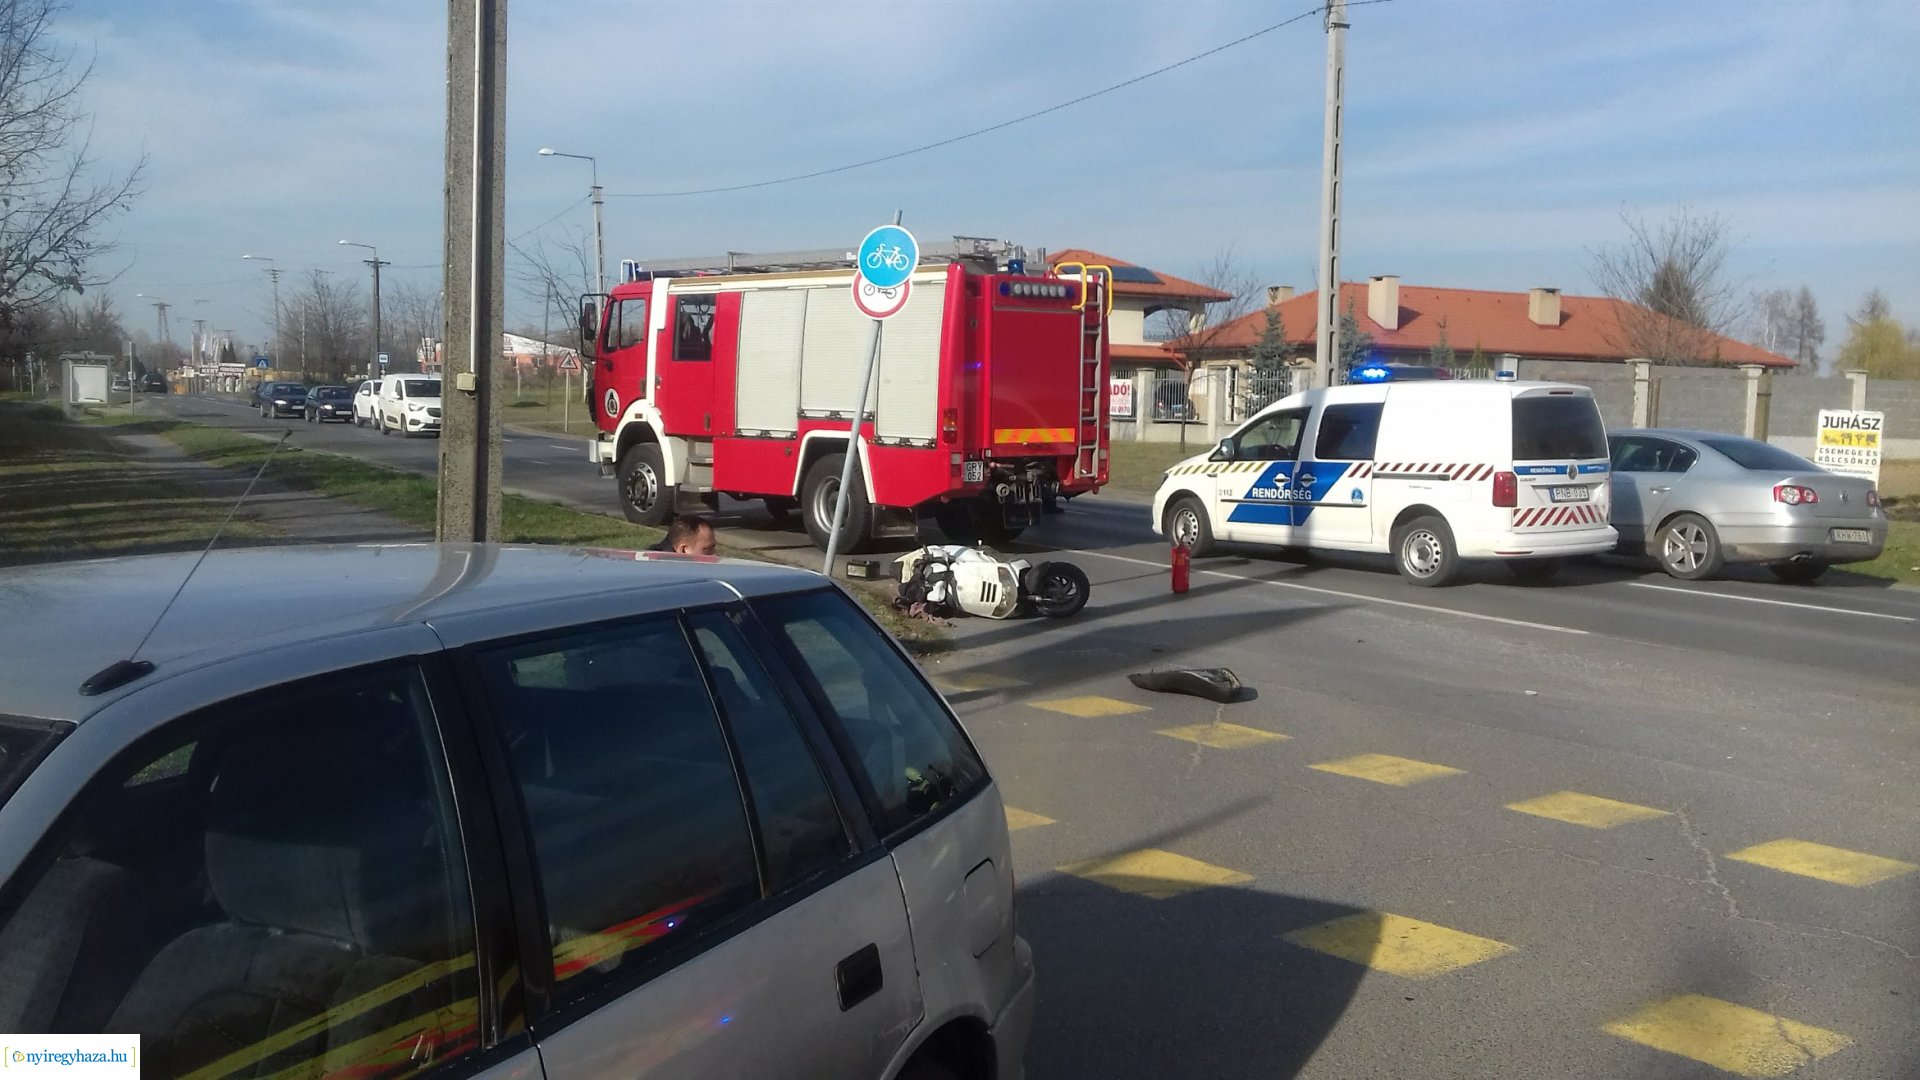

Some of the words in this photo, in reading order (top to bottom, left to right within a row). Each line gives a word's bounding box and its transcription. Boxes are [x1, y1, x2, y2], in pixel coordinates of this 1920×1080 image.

[1822, 414, 1881, 430] JUHÁSZ
[1819, 448, 1863, 456] CSEMEGE
[966, 462, 982, 472] GRY
[967, 472, 982, 481] 052
[1252, 487, 1312, 500] RENDŐRSÉG
